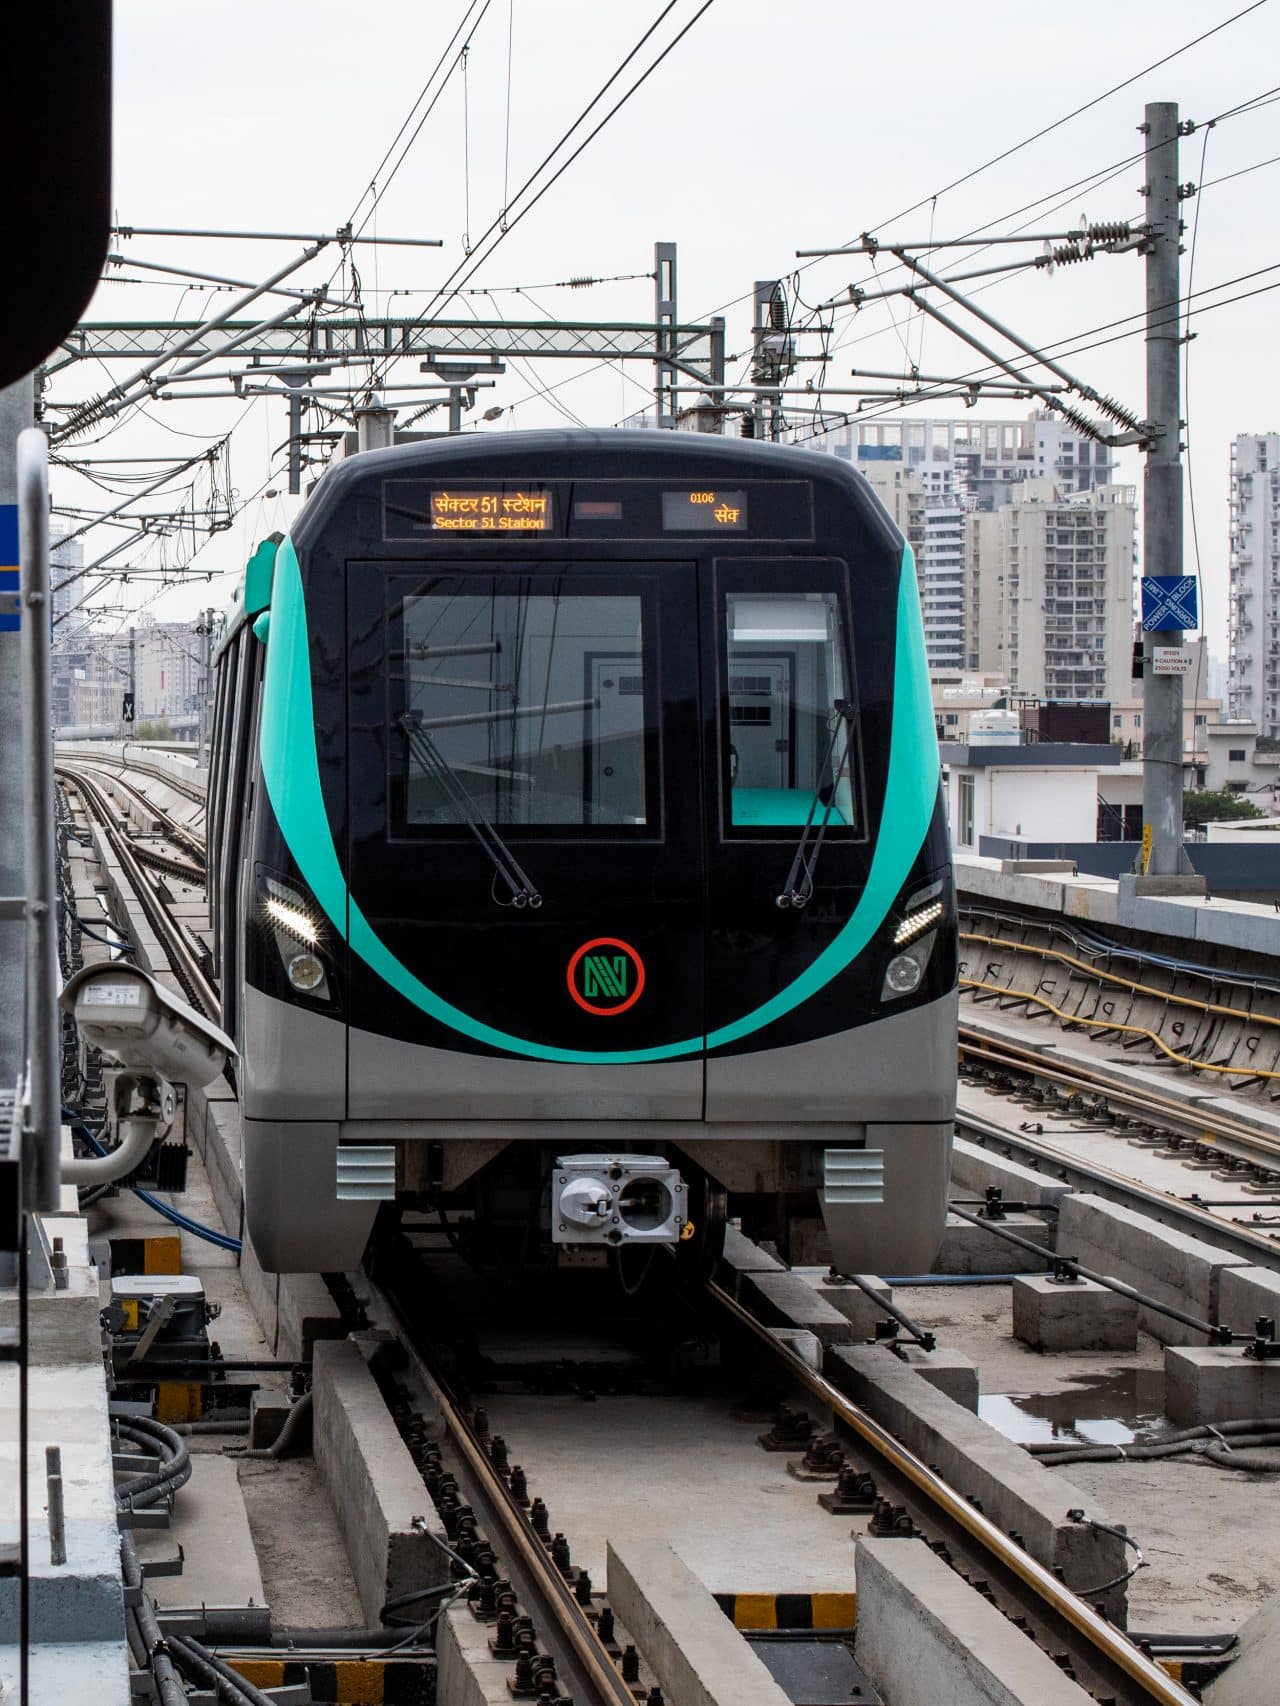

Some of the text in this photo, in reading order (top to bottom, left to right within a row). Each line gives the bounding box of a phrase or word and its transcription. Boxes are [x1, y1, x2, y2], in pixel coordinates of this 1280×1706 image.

[435, 493, 546, 513] सेक्टर 51 स्टेशन
[690, 492, 715, 504] 0106
[435, 517, 545, 529] Sector 51 Station
[1143, 577, 1195, 631] POWER BLOCK
[1164, 598, 1197, 630] WORKING
